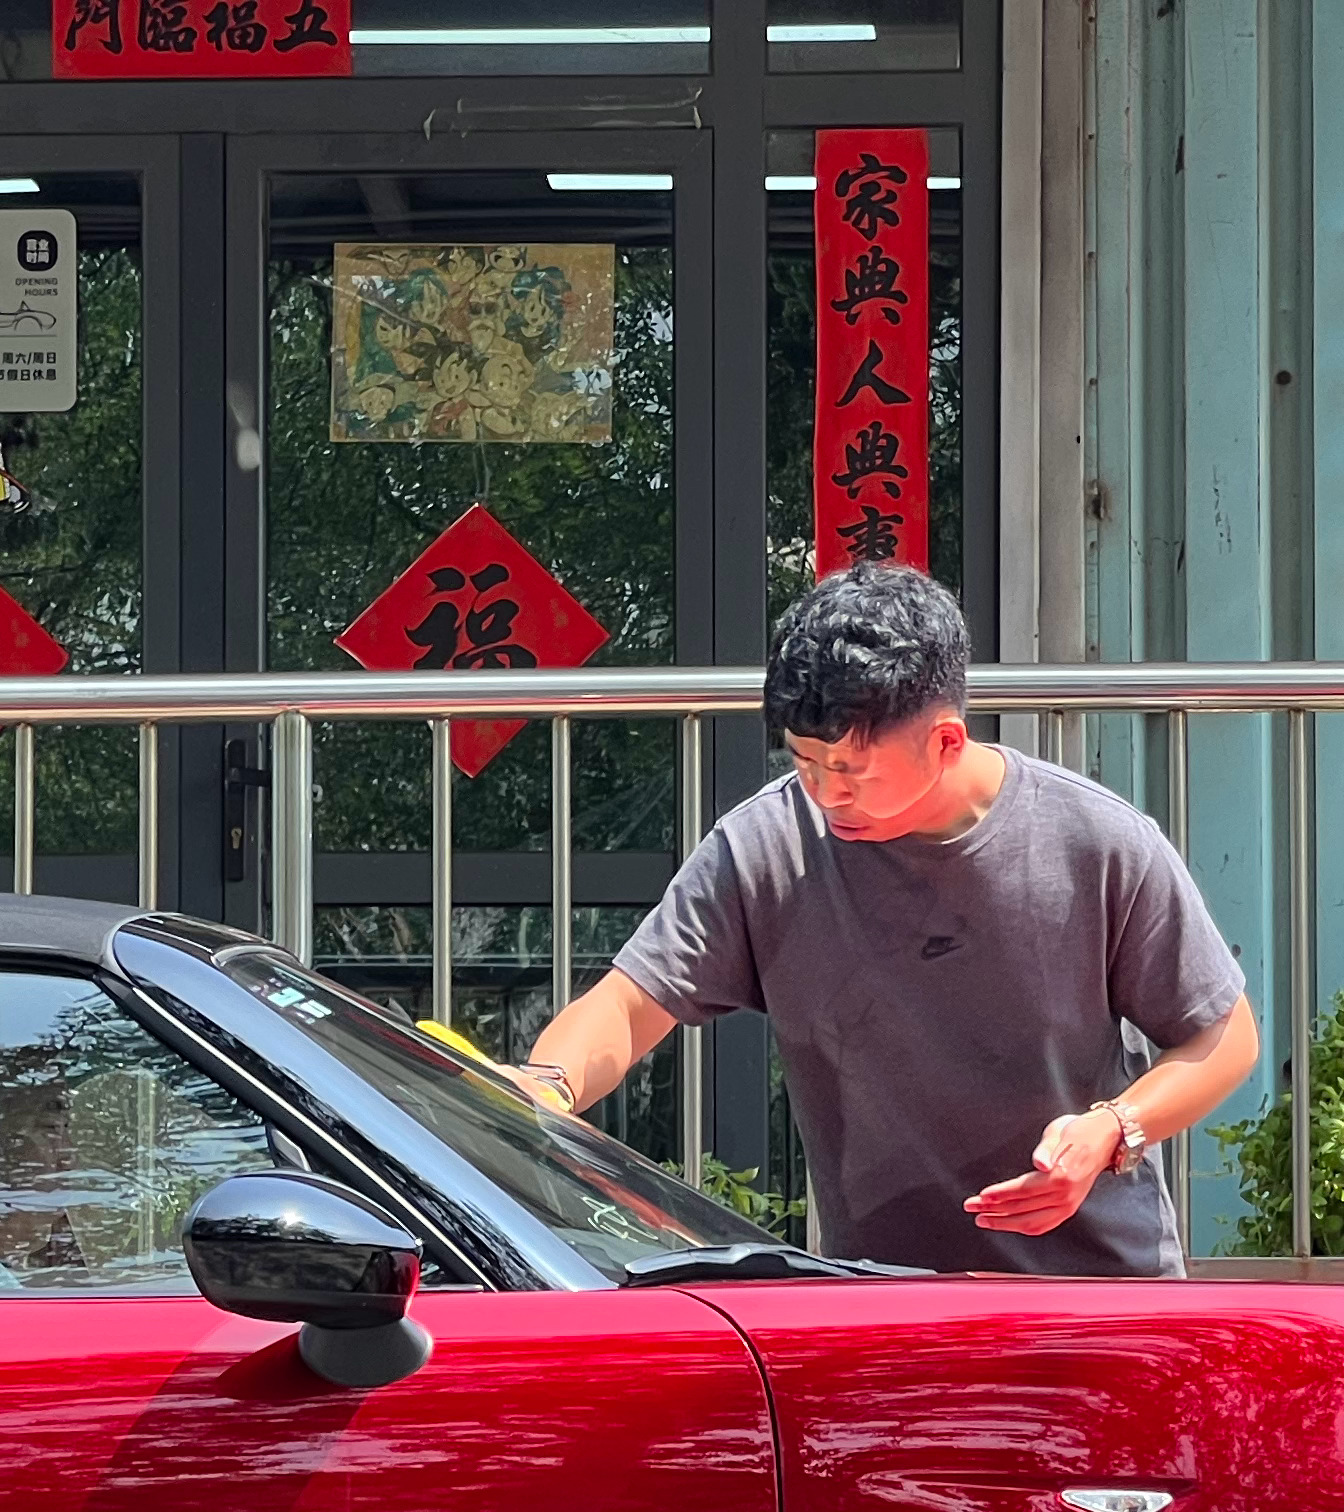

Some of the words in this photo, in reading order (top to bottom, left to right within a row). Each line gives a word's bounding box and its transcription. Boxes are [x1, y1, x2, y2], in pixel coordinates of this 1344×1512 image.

[15, 277, 58, 286] OPENING
[24, 288, 58, 296] HOURS
[2, 352, 57, 365] 周六/周日
[403, 562, 538, 670] 福
